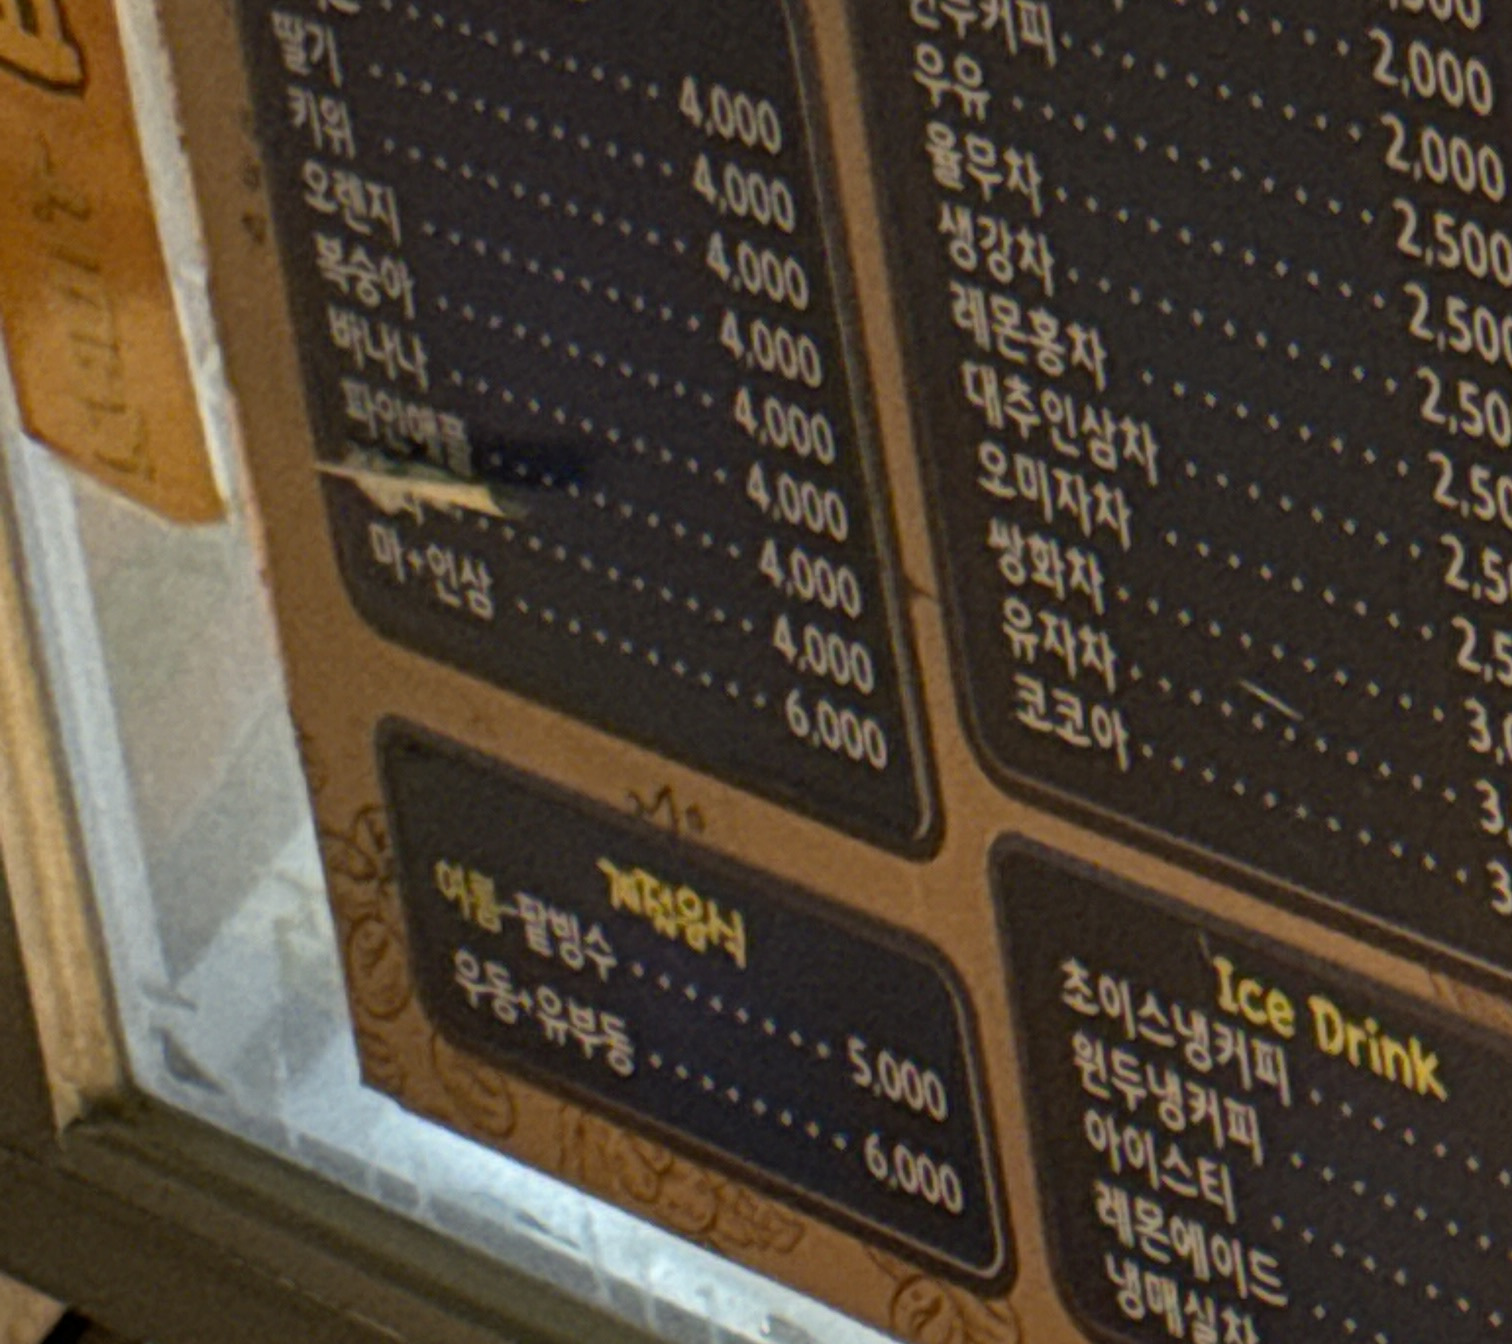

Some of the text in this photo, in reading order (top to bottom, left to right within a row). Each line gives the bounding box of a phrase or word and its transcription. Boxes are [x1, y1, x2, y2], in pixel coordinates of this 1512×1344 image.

[271, 9, 793, 230] 딸기 4,000
[680, 77, 780, 152] 4,000
[913, 41, 992, 123] 우유
[1372, 28, 1492, 114] 2,000
[287, 85, 807, 308] 키위 4,000
[925, 121, 1043, 218] 율무차
[1384, 114, 1504, 201] 2,000
[302, 160, 820, 387] 오렌지 4,000
[938, 203, 1054, 297] 생강차
[313, 232, 833, 463] 복숭아 4,000
[950, 281, 1107, 392] 레몬홍차
[329, 304, 847, 541] 바나나 4,000
[961, 361, 1159, 486] 대추인삼차
[978, 441, 1133, 552] 오미자차
[760, 540, 859, 617] 4,000
[987, 517, 1105, 615] 쌍화차
[774, 615, 872, 692] 4,000
[1002, 597, 1118, 695] 유자차
[786, 690, 886, 768] 6,000
[1012, 672, 1130, 773] 코코아
[849, 1038, 945, 1119] 5,000
[1061, 957, 1291, 1107] 초이스냉커피
[1212, 956, 1448, 1102] Ice Drink
[1071, 1029, 1264, 1167] 원두냉커피
[865, 1133, 962, 1211] 6,000
[1085, 1109, 1236, 1225] 아이스티
[1095, 1179, 1288, 1308] 레몬에이드
